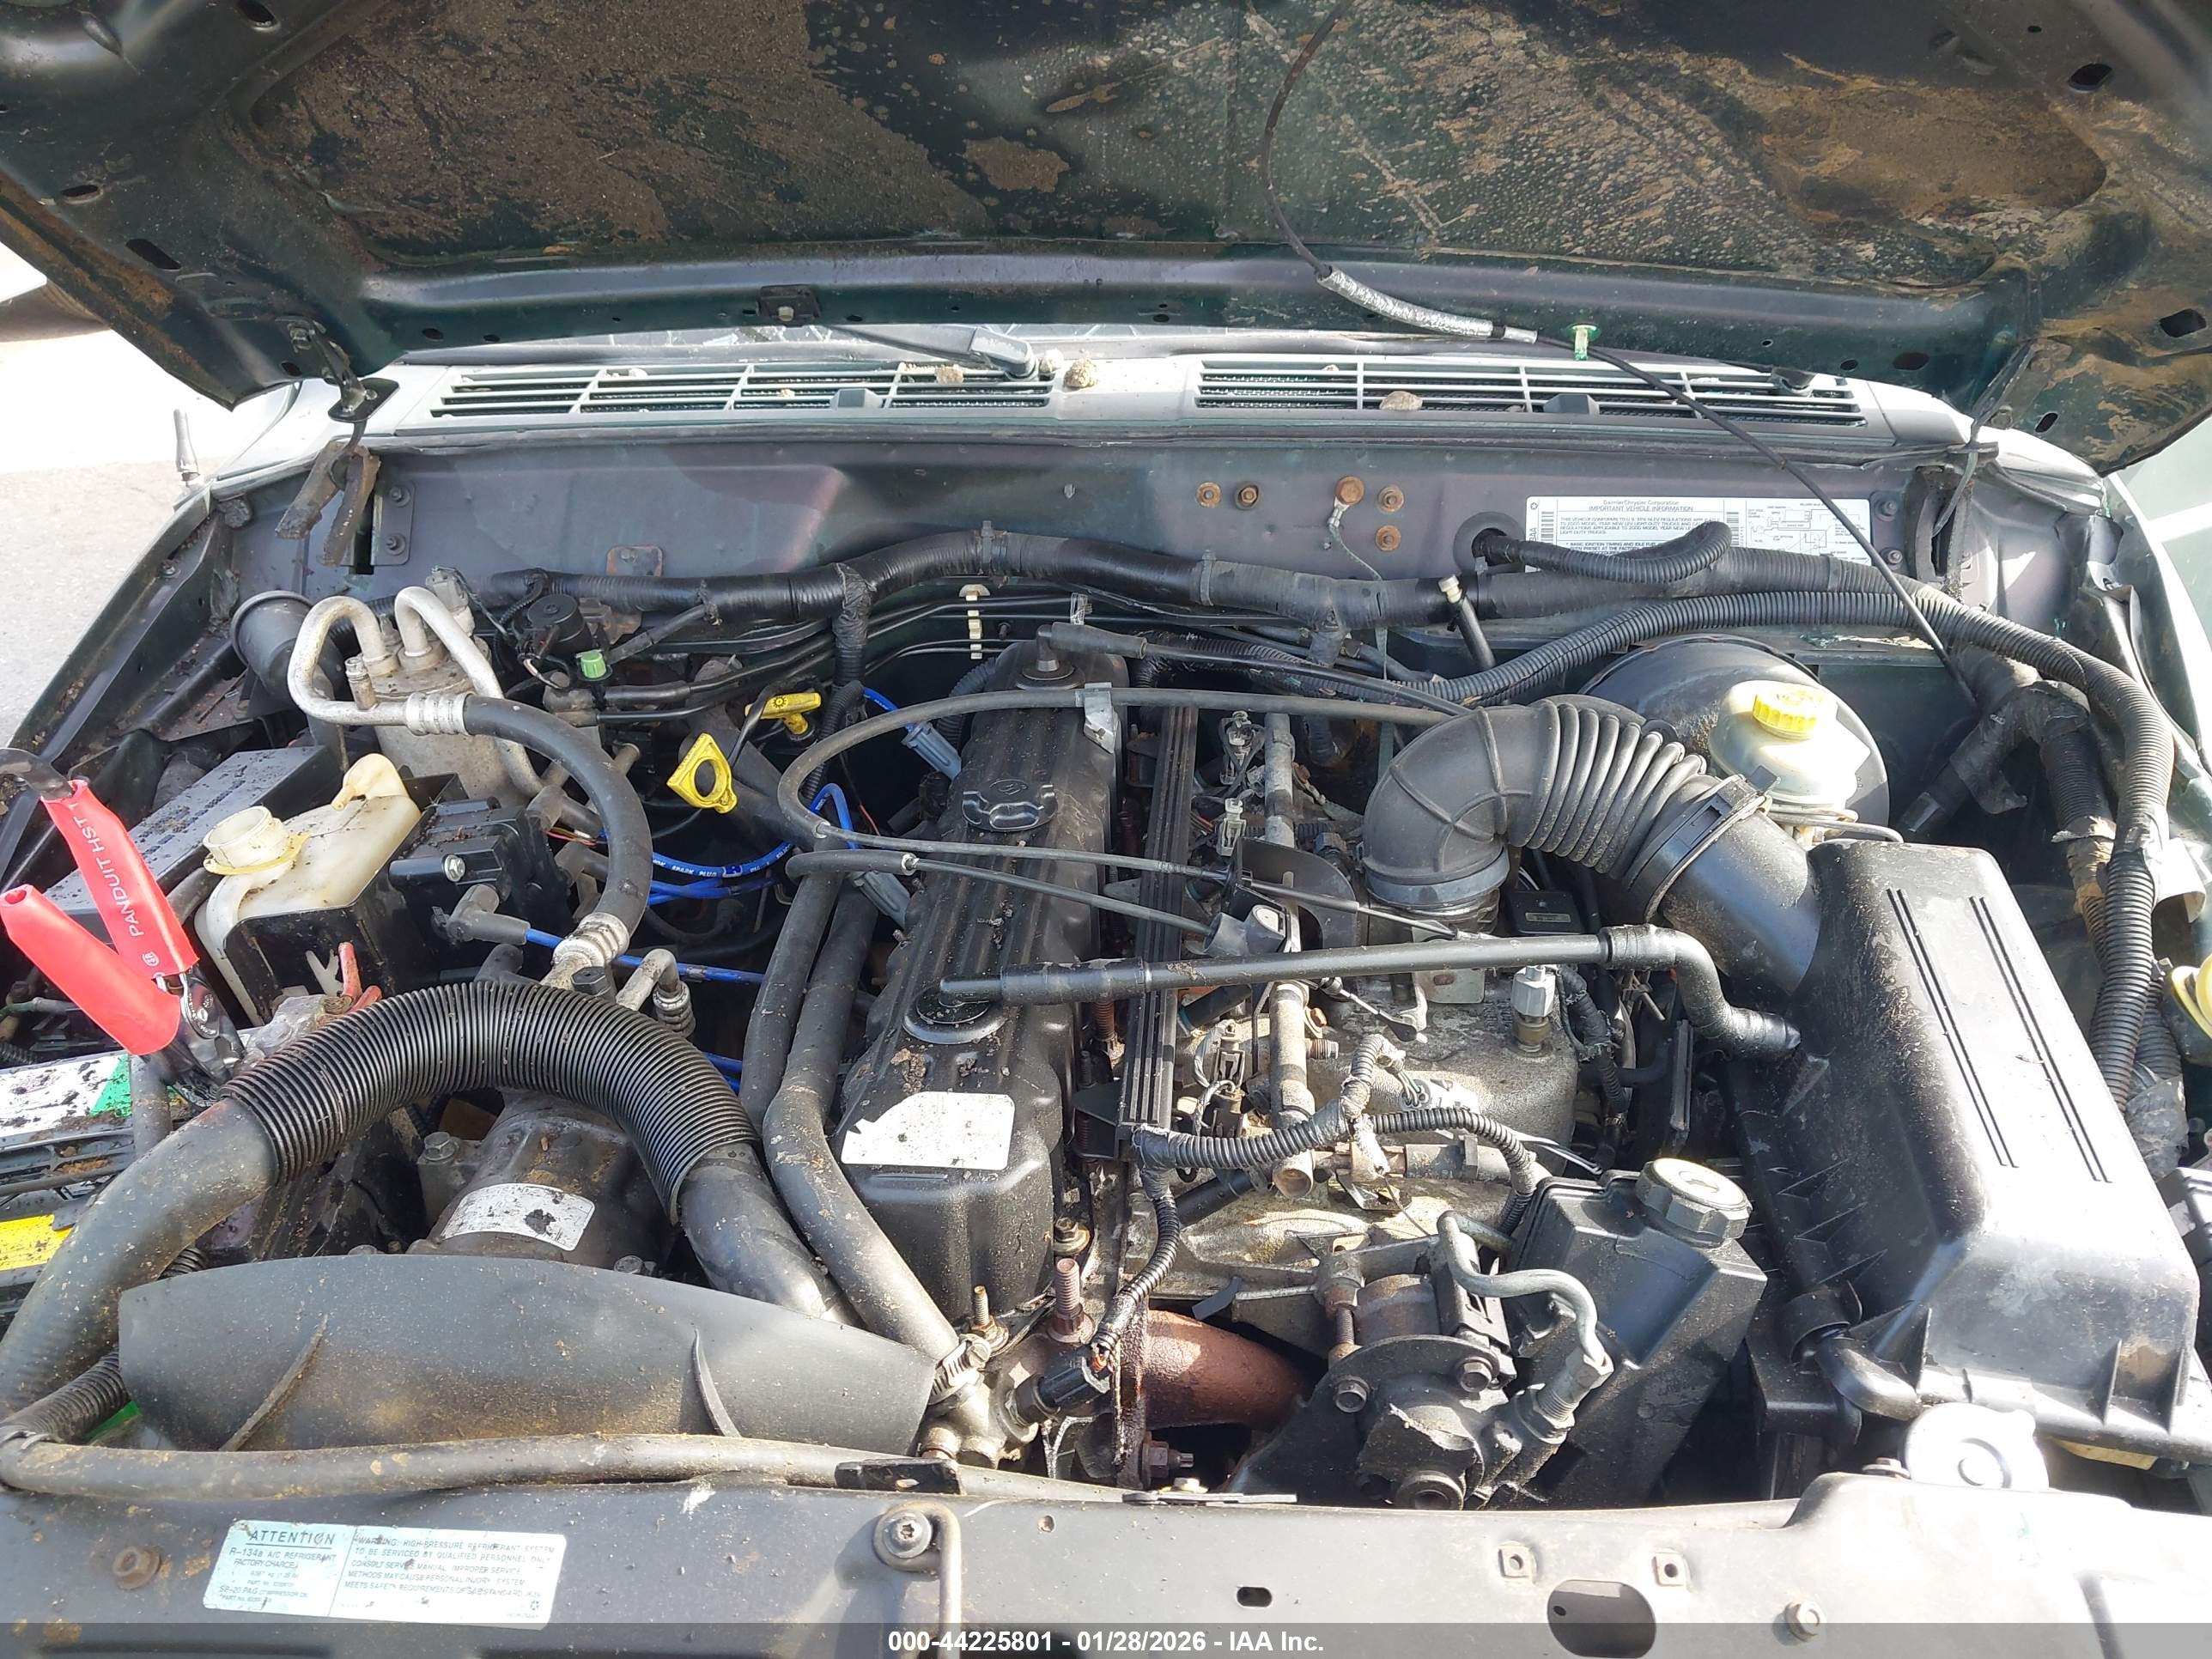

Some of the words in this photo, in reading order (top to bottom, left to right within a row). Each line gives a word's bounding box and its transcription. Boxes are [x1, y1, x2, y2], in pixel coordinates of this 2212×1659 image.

[73, 816, 106, 853] HST
[95, 857, 145, 937] PANDUIT
[249, 1529, 336, 1546] ATTENTION
[228, 1547, 264, 1557] R-134a
[283, 1552, 337, 1562] REFRIGERANT
[234, 1558, 264, 1566] FACTORY
[355, 1547, 365, 1555] TO
[381, 1549, 420, 1558] SERVICED
[437, 1551, 477, 1560] QUALIFIED
[480, 1553, 526, 1562] PERSONNEL
[351, 1559, 385, 1569] CONSULT
[348, 1571, 382, 1579] METHODS
[425, 1575, 463, 1584] PERSONAL
[398, 1584, 454, 1594] REQUIREMENTS
